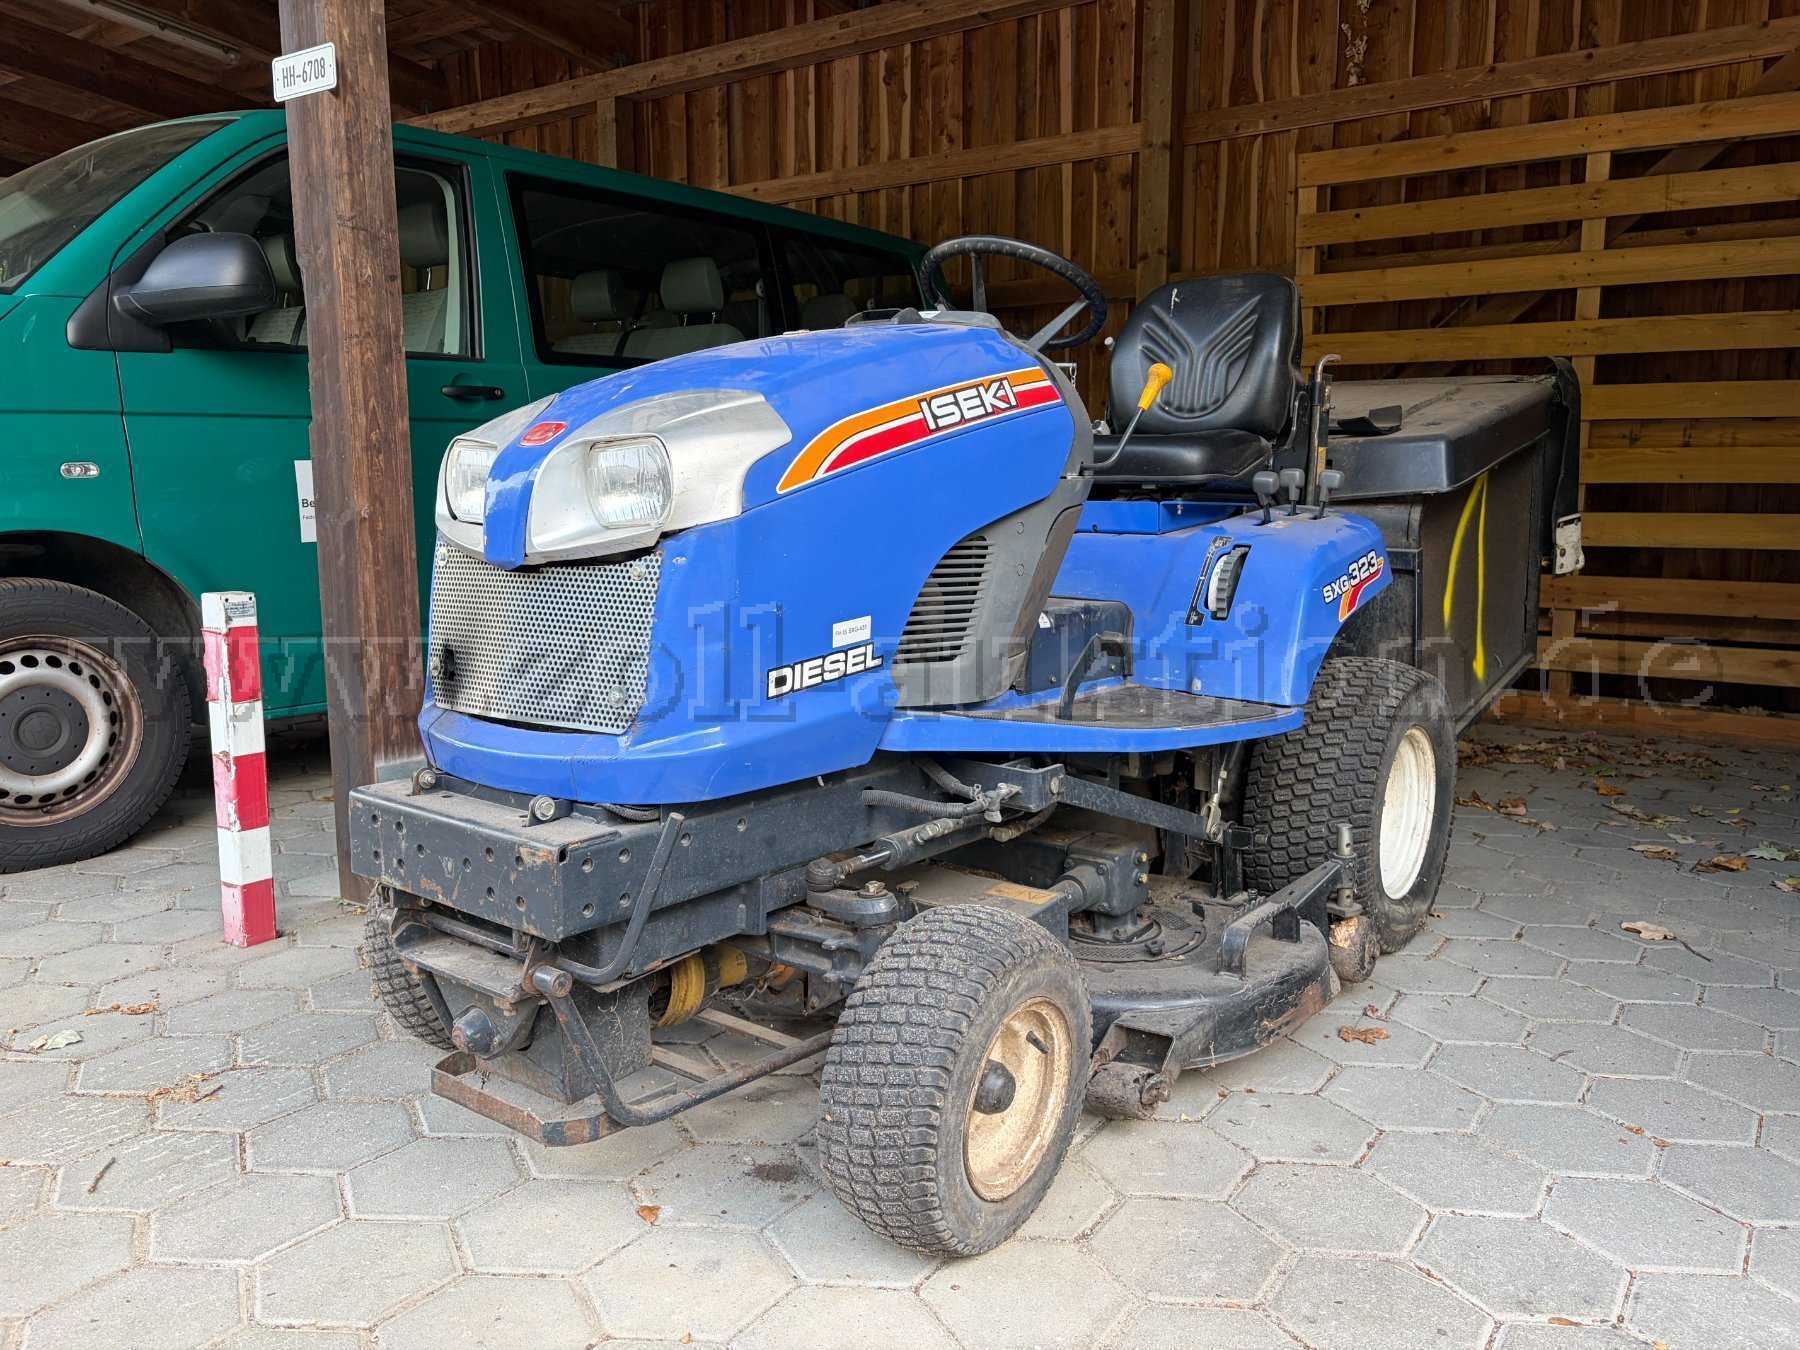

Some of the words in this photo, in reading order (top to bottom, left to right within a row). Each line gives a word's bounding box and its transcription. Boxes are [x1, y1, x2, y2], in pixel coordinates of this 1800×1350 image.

[281, 57, 326, 89] HH-6708
[919, 377, 1019, 432] ISEKI
[767, 642, 883, 700] DIESEL
